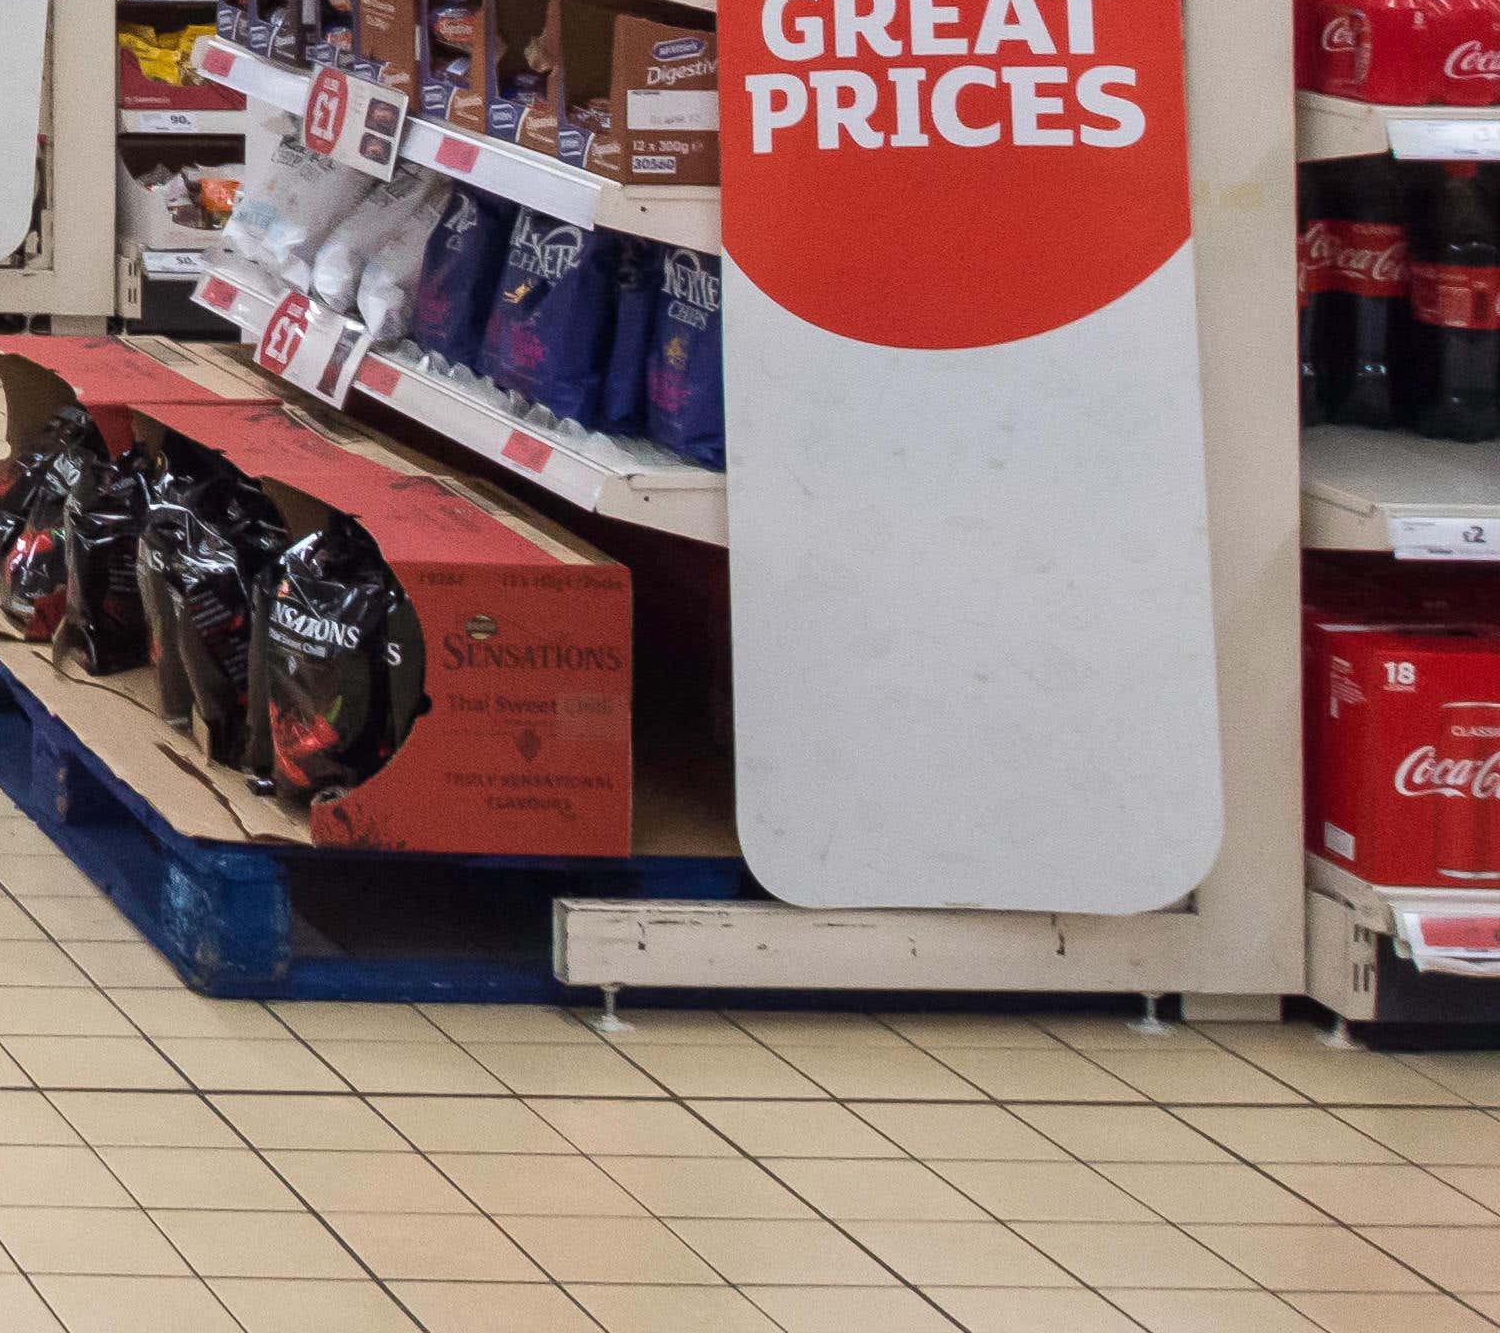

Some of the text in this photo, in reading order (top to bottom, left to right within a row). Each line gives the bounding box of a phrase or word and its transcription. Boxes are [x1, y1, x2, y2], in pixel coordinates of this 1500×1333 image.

[745, 65, 1146, 155] PRICES
[1383, 661, 1417, 687] 18
[496, 697, 558, 714] Sweet
